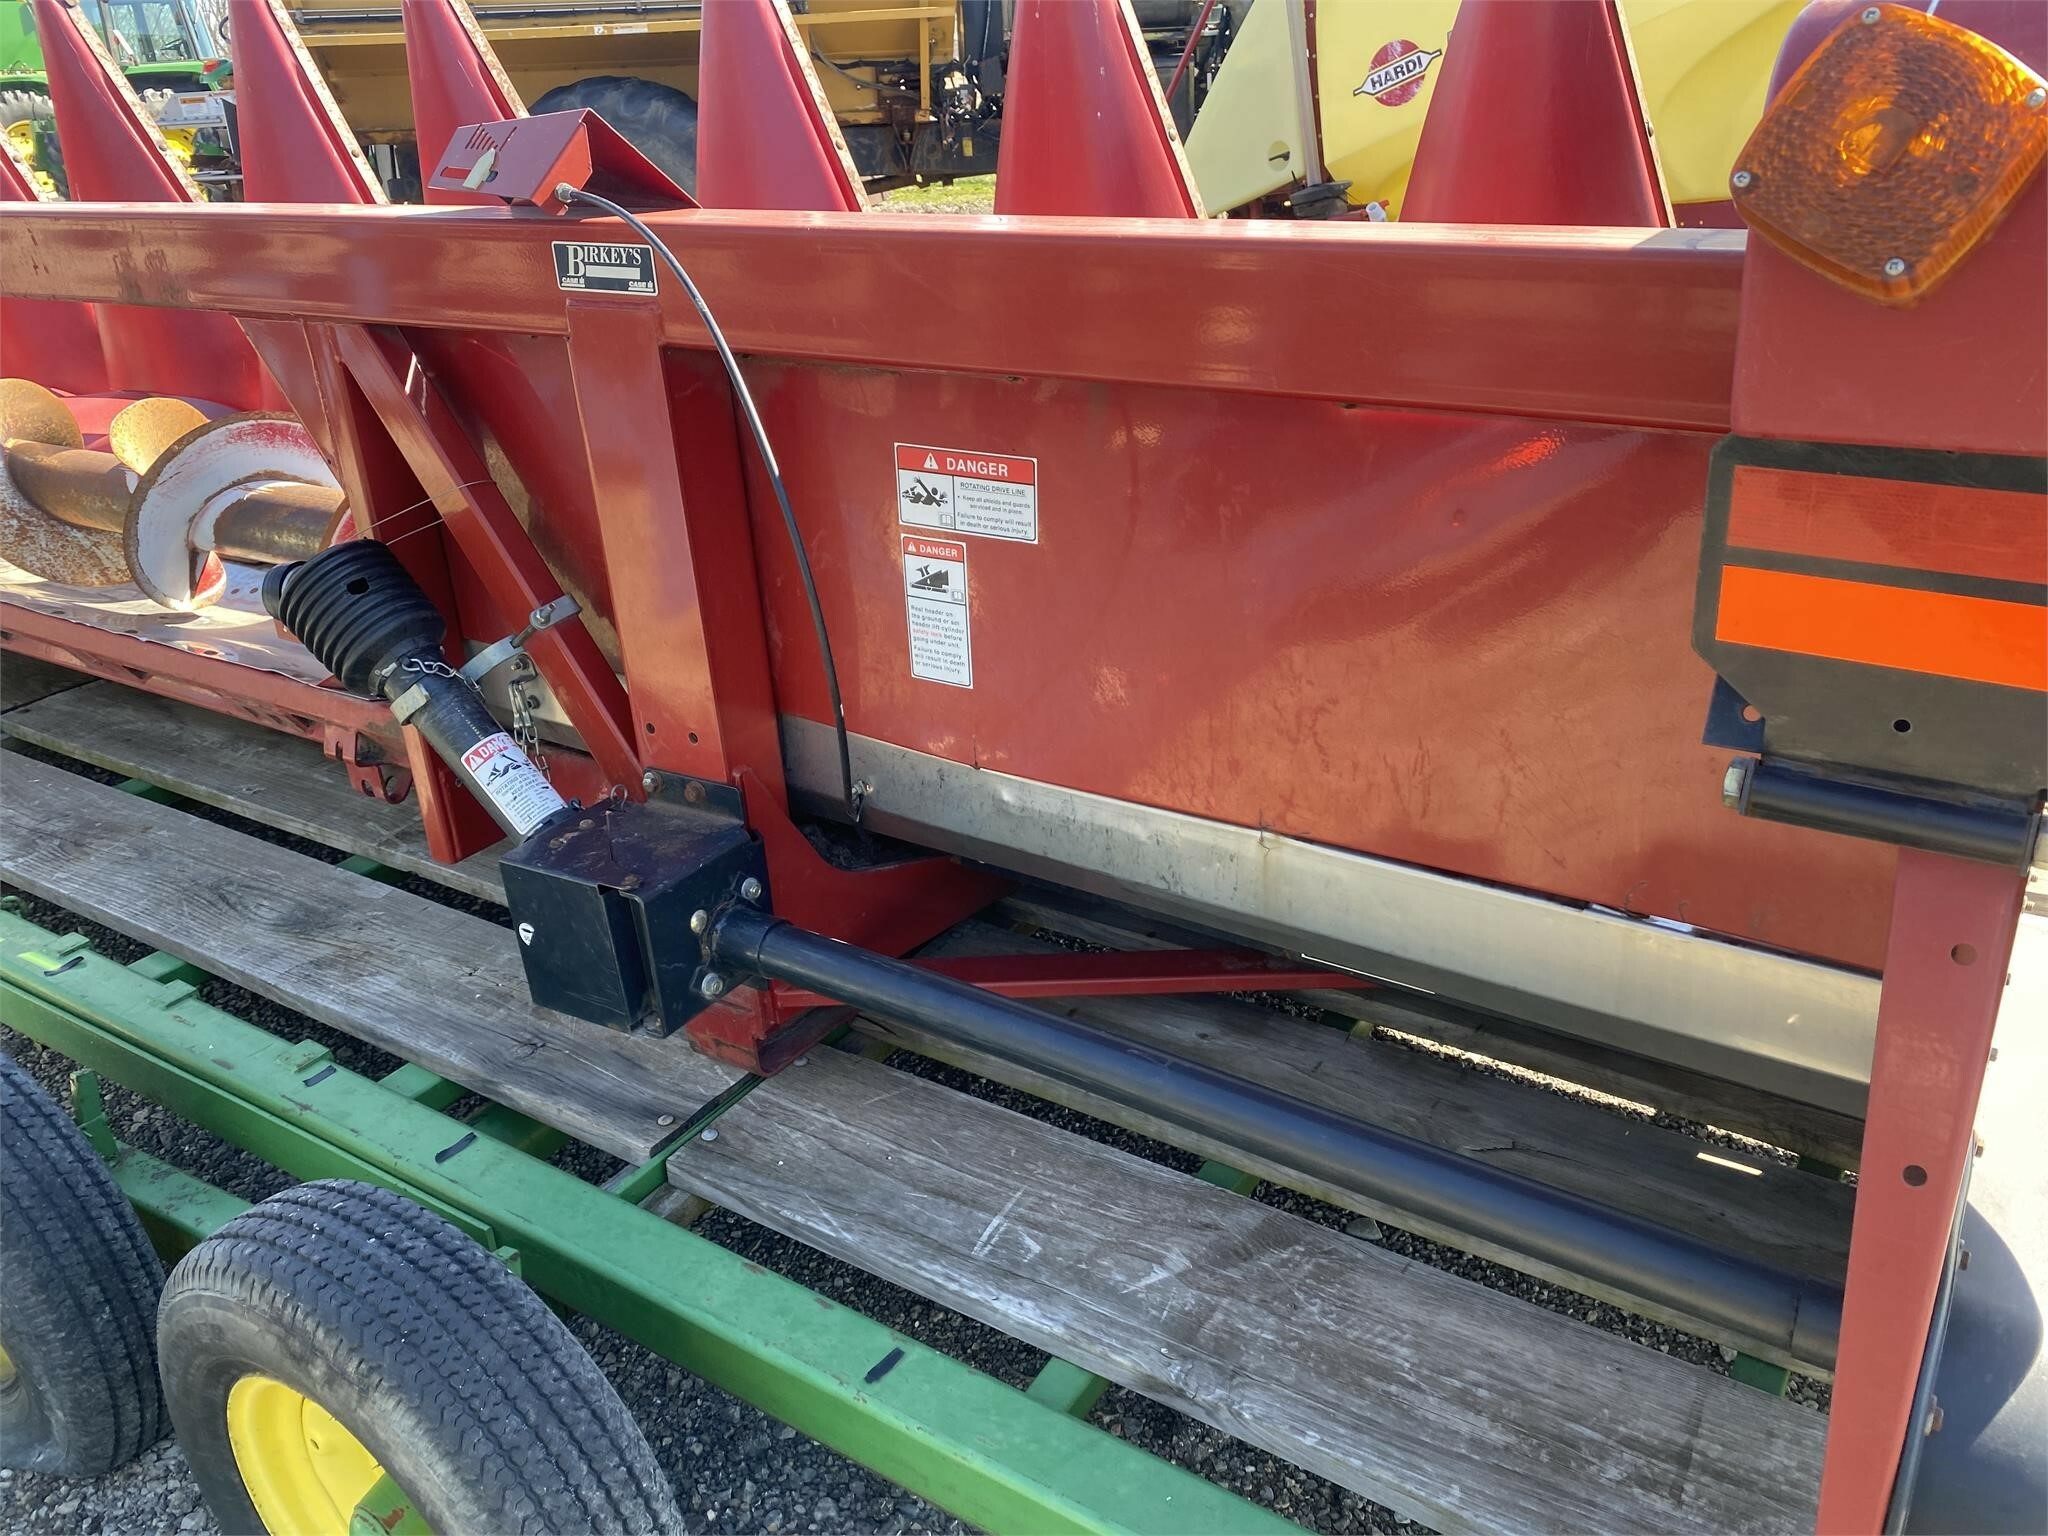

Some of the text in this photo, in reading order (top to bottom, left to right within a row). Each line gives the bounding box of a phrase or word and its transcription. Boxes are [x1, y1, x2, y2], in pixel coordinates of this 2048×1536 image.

[1370, 55, 1424, 90] HARDI
[566, 246, 642, 276] BIRKEY'S
[946, 458, 1008, 476] DANGER
[960, 482, 990, 492] ROTATING
[920, 544, 958, 558] DANGER
[941, 652, 961, 660] comply
